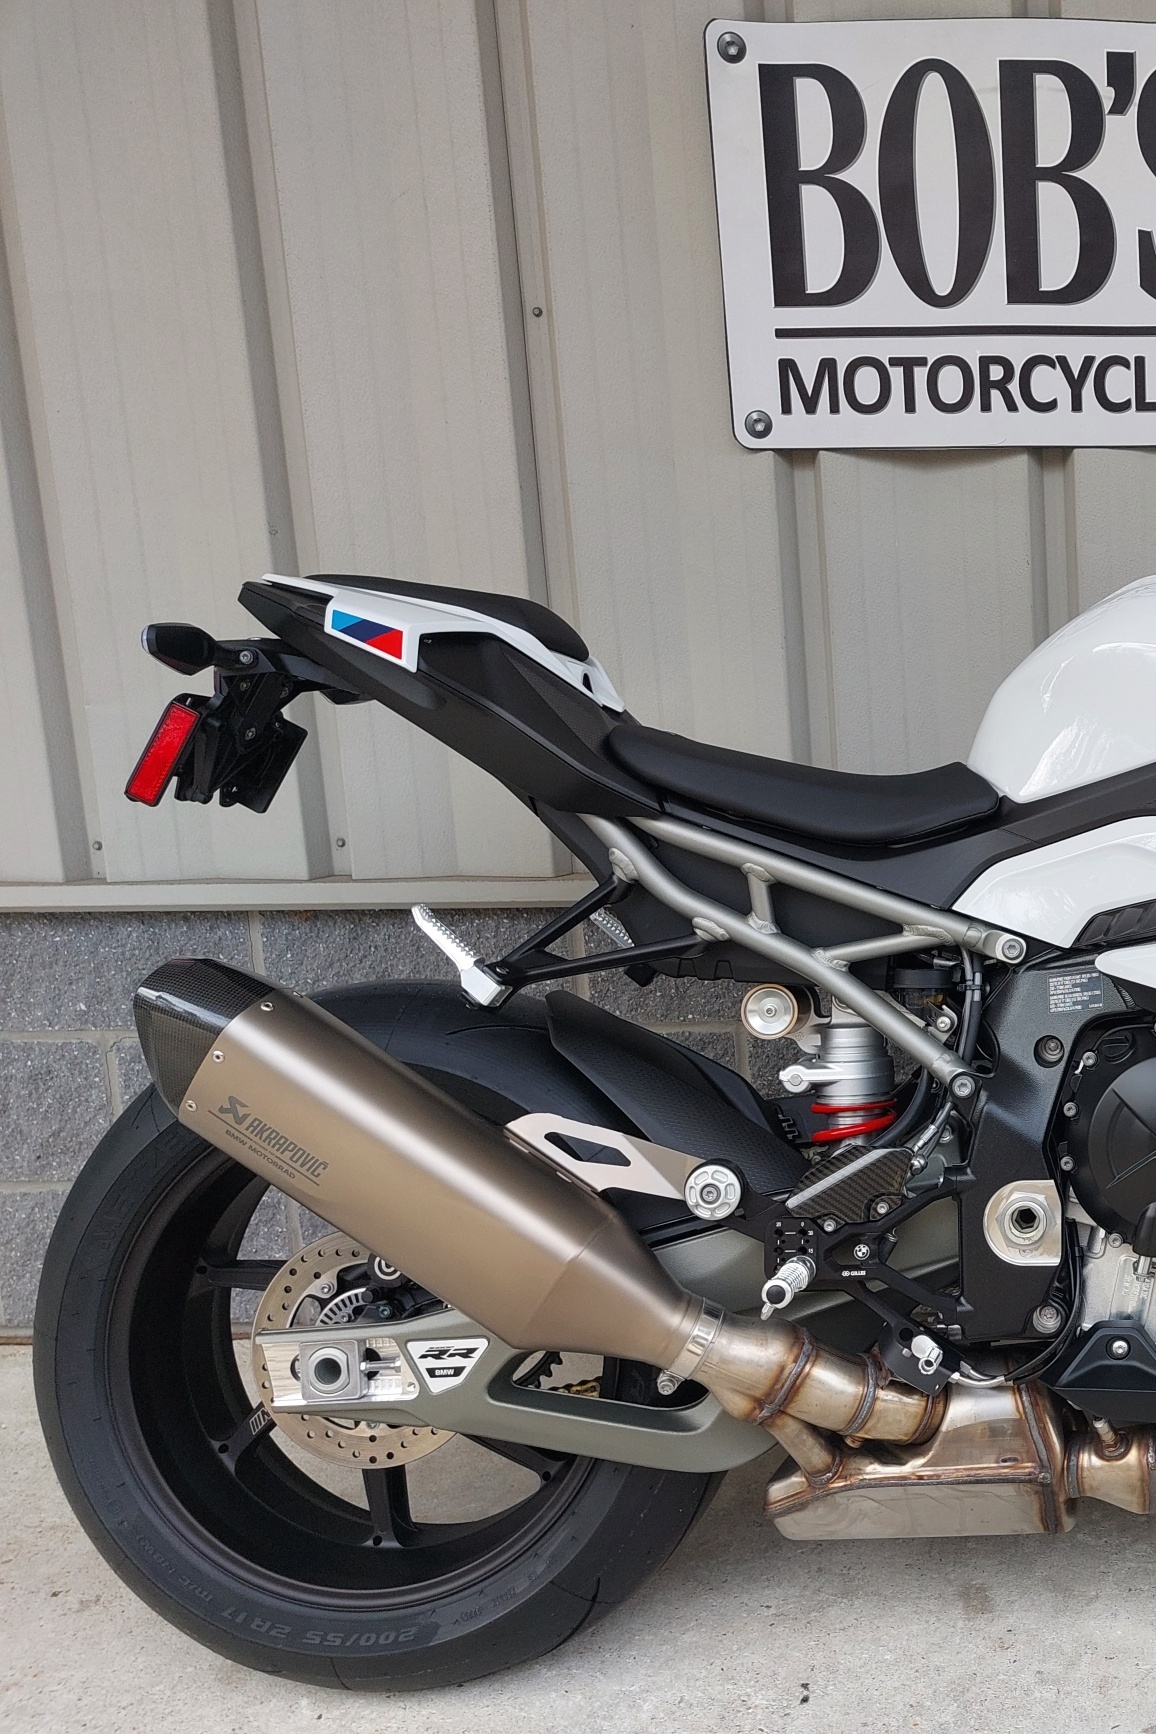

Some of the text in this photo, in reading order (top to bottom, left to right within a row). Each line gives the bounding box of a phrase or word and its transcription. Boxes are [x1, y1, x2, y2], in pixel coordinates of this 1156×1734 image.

[225, 1129, 248, 1146] BMW
[248, 1144, 296, 1179] MOTORRAD
[418, 1347, 480, 1360] RR
[434, 1368, 455, 1376] BMW
[302, 1625, 419, 1647] 200/55
